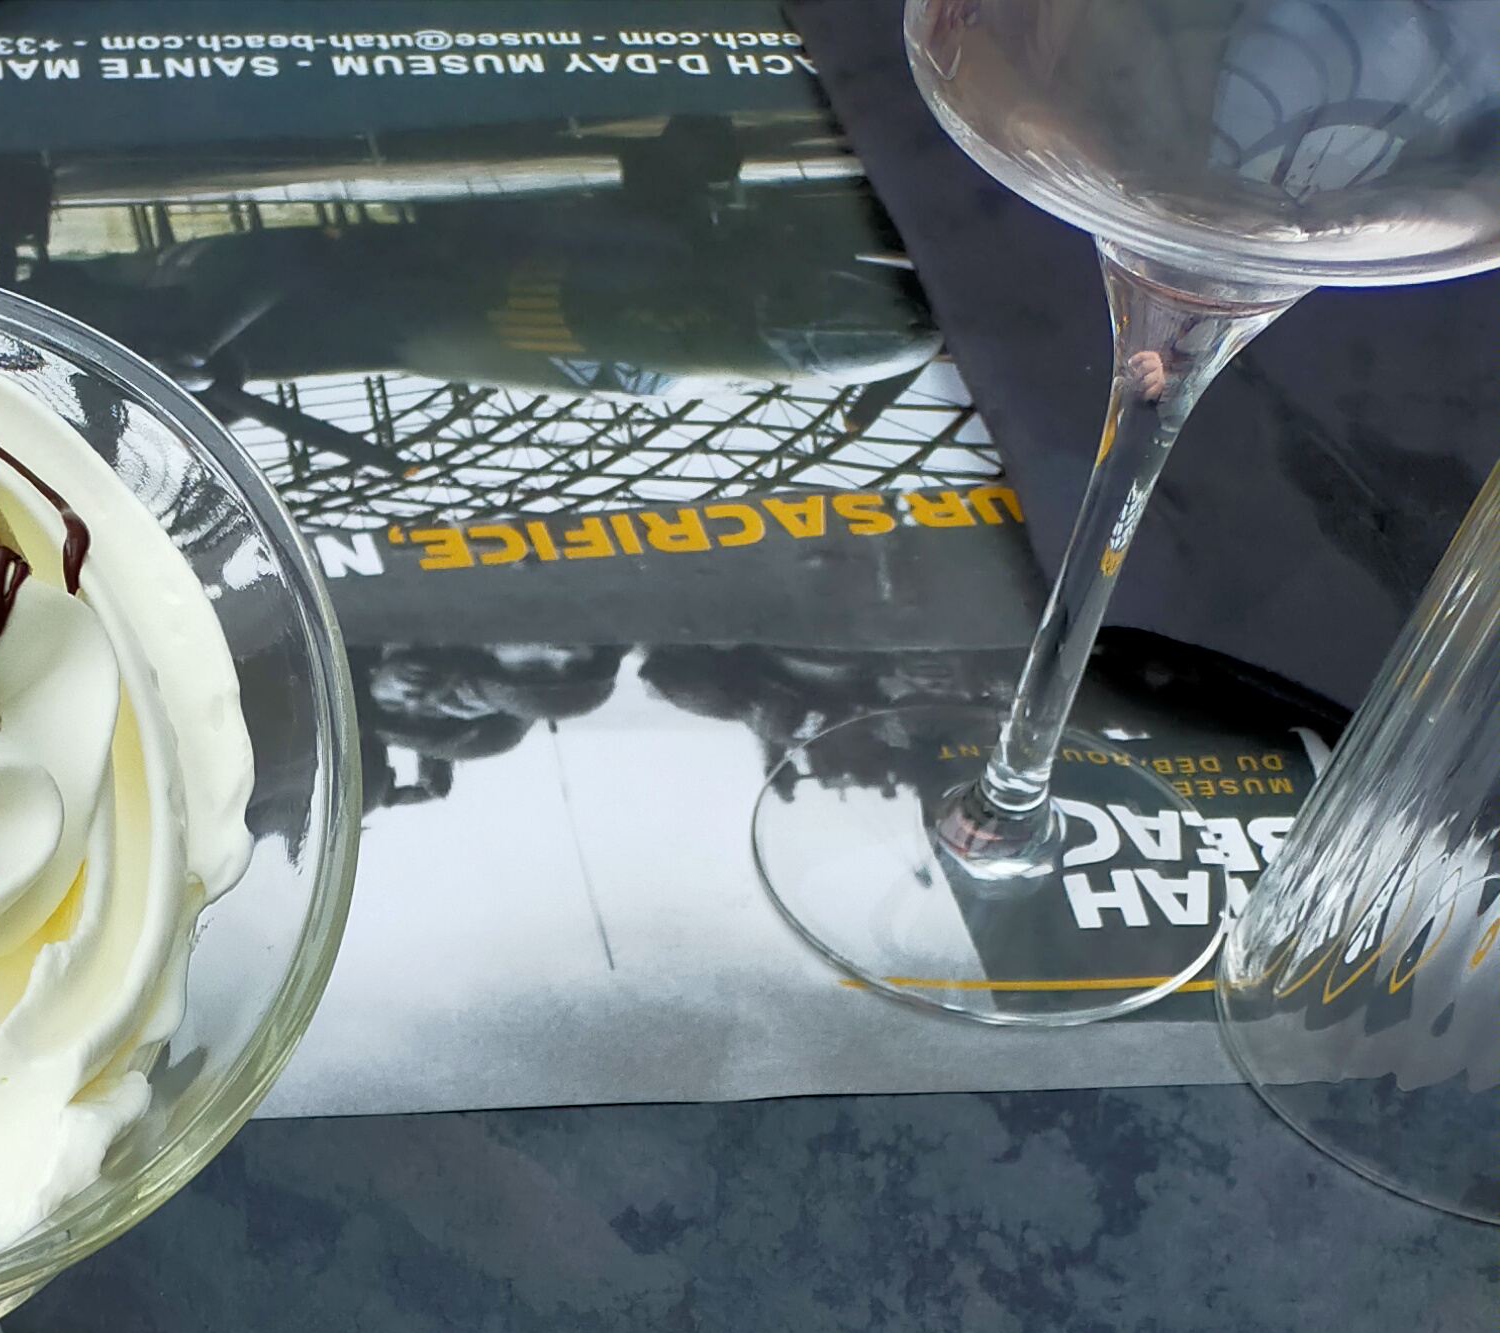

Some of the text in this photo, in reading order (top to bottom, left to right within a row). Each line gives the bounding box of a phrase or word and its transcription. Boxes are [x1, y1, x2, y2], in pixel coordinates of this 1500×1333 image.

[100, 29, 582, 56] musee@utah-beach.com
[98, 56, 280, 79] SAINTE
[331, 53, 546, 76] MUSEUM
[564, 52, 711, 76] D-DAY
[905, 485, 1024, 527] UR
[388, 491, 897, 571] SACRIFICE,
[1235, 754, 1285, 772] DU
[1171, 778, 1294, 800] MUSÉE
